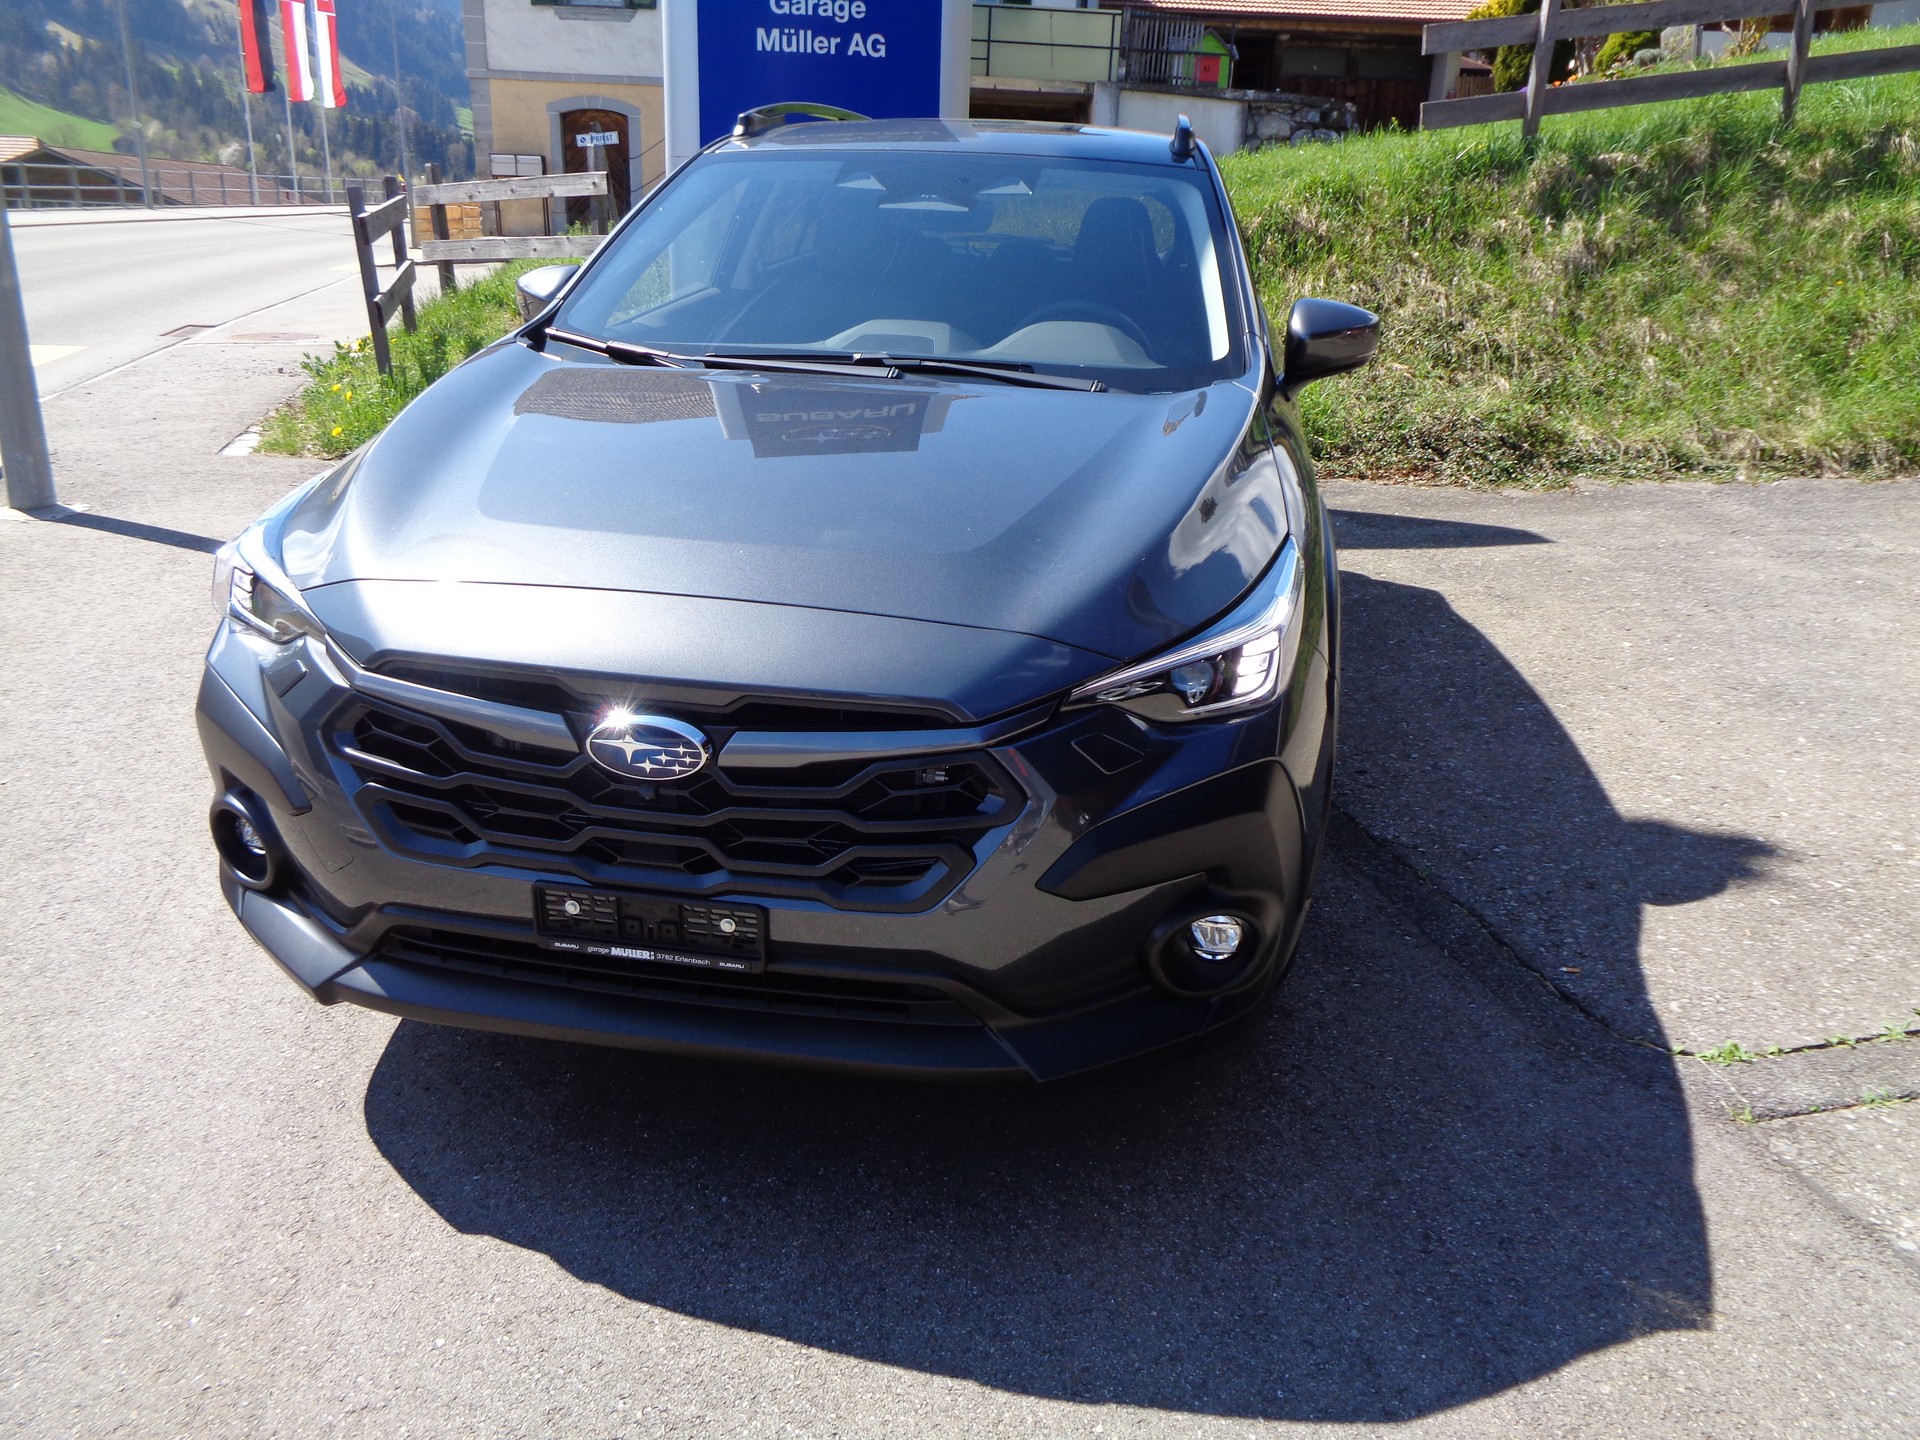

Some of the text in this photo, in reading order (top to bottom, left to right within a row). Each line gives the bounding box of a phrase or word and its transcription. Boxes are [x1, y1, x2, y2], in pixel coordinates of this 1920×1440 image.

[769, 0, 866, 23] Garage
[756, 27, 886, 58] Müller AG
[591, 134, 613, 143] PRIVAT
[587, 946, 610, 954] garage
[656, 953, 674, 961] 3762
[675, 955, 711, 965] Erlenbach
